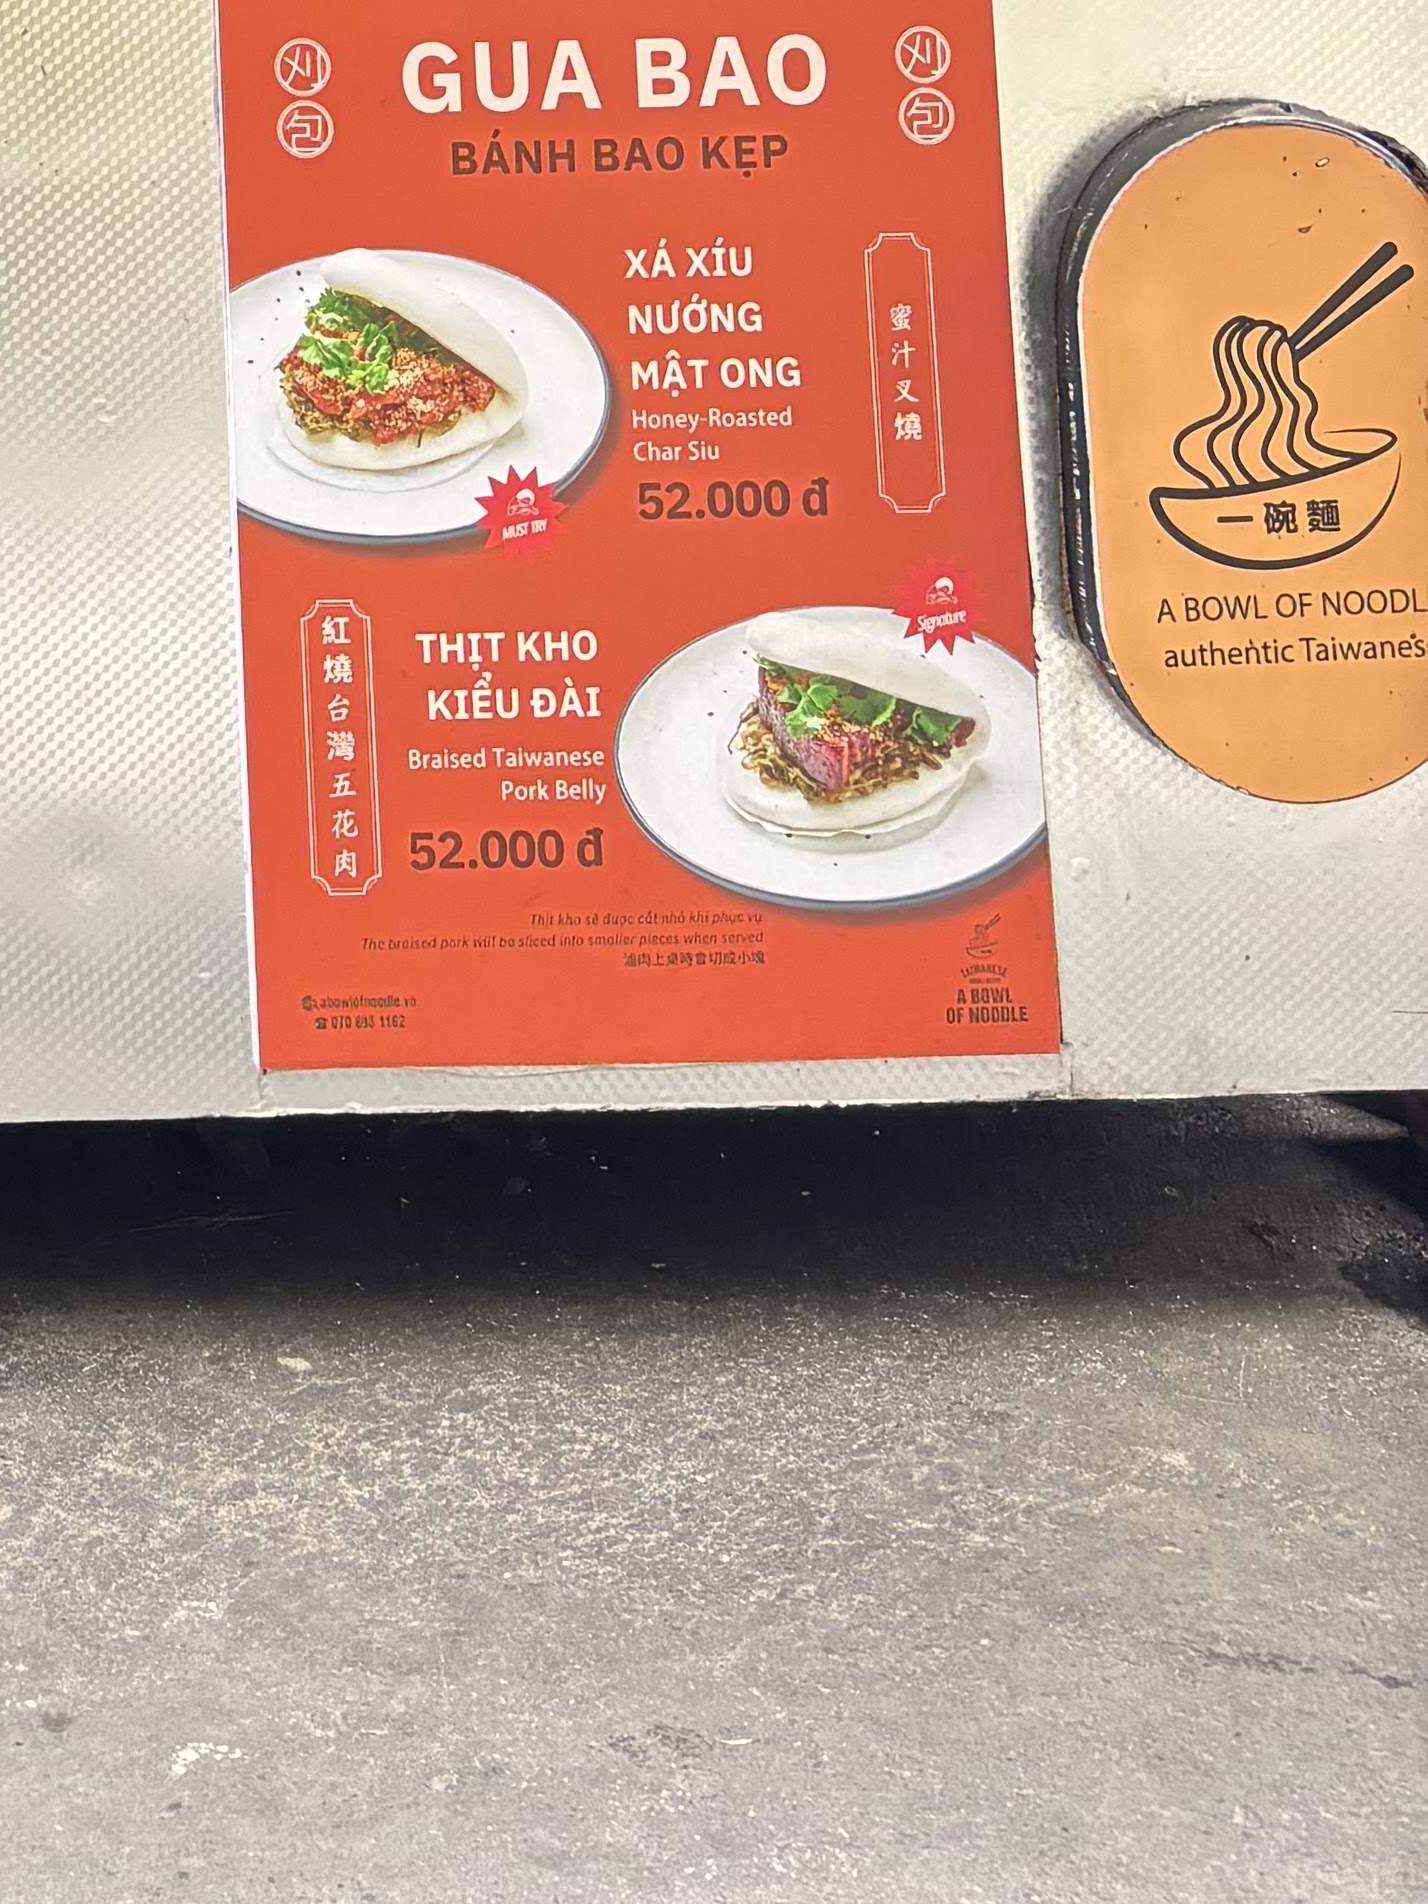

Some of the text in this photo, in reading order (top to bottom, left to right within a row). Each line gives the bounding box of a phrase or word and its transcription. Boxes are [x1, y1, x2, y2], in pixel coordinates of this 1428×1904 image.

[401, 33, 827, 115] GUA BAO
[450, 130, 789, 179] BÁNH BAO KẸP
[624, 237, 753, 279] XÁ XÍU
[628, 293, 763, 334] NƯỚNG
[631, 349, 801, 398] MẬT ONG
[889, 303, 923, 442] 蜜汁叉燒
[631, 405, 793, 433] Honey-Roasted
[632, 440, 720, 462] Char Siu
[638, 476, 830, 520] 52.000 đ
[1217, 498, 1341, 534] 一碗麵
[502, 521, 530, 541] MUST
[917, 609, 967, 633] Signature
[1157, 588, 1428, 624] A BOWL OF NOODL
[415, 629, 598, 672] THỊT KHO
[1164, 636, 1428, 669] authentic Taiwanes
[427, 671, 601, 720] KIỂU ĐÀI
[321, 615, 359, 878] 紅燒台灣五花肉
[408, 747, 605, 770] Braised Taiwanese
[500, 778, 606, 805] Pork Belly
[410, 827, 604, 871] 52.000 đ
[558, 913, 580, 925] kho
[362, 937, 385, 951] The
[388, 937, 436, 950] braised
[439, 936, 469, 950] pork
[473, 936, 496, 948] will
[518, 935, 556, 948] sliced
[560, 935, 584, 947] into
[587, 933, 635, 946] smaller
[639, 933, 680, 947] pieces
[683, 933, 717, 945] when
[721, 932, 764, 944] served
[957, 987, 1013, 1005] A BOWL
[946, 1006, 1029, 1024] OF NOODLE
